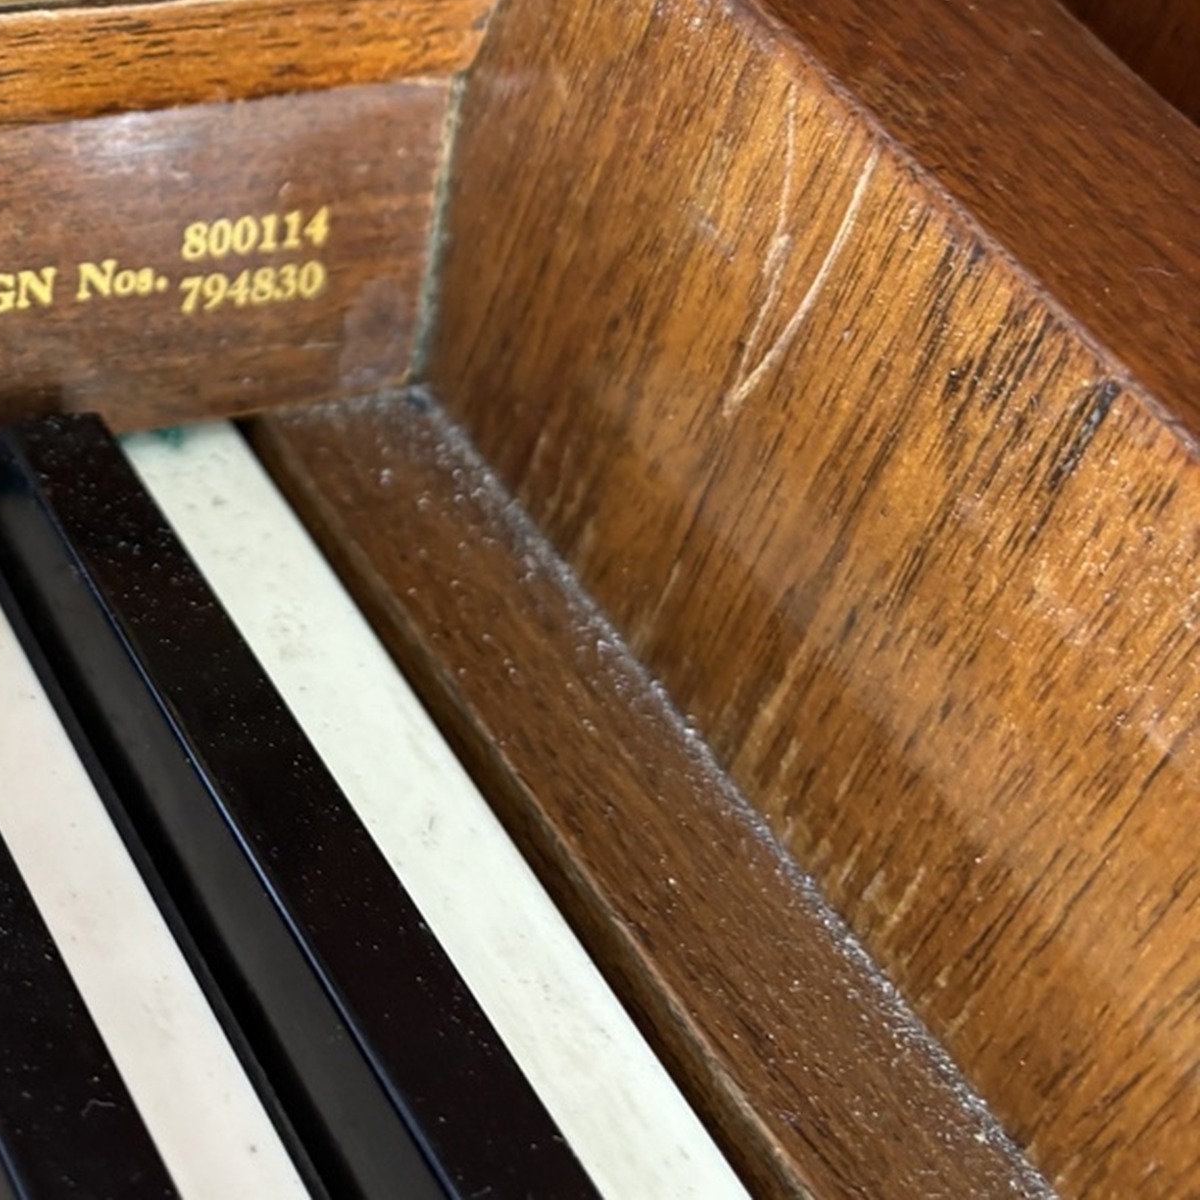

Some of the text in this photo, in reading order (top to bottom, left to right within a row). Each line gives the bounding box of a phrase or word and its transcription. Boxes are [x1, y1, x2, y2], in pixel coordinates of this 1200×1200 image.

[180, 206, 330, 262] 800114
[75, 258, 168, 302] Nos.
[178, 260, 326, 314] 794830
